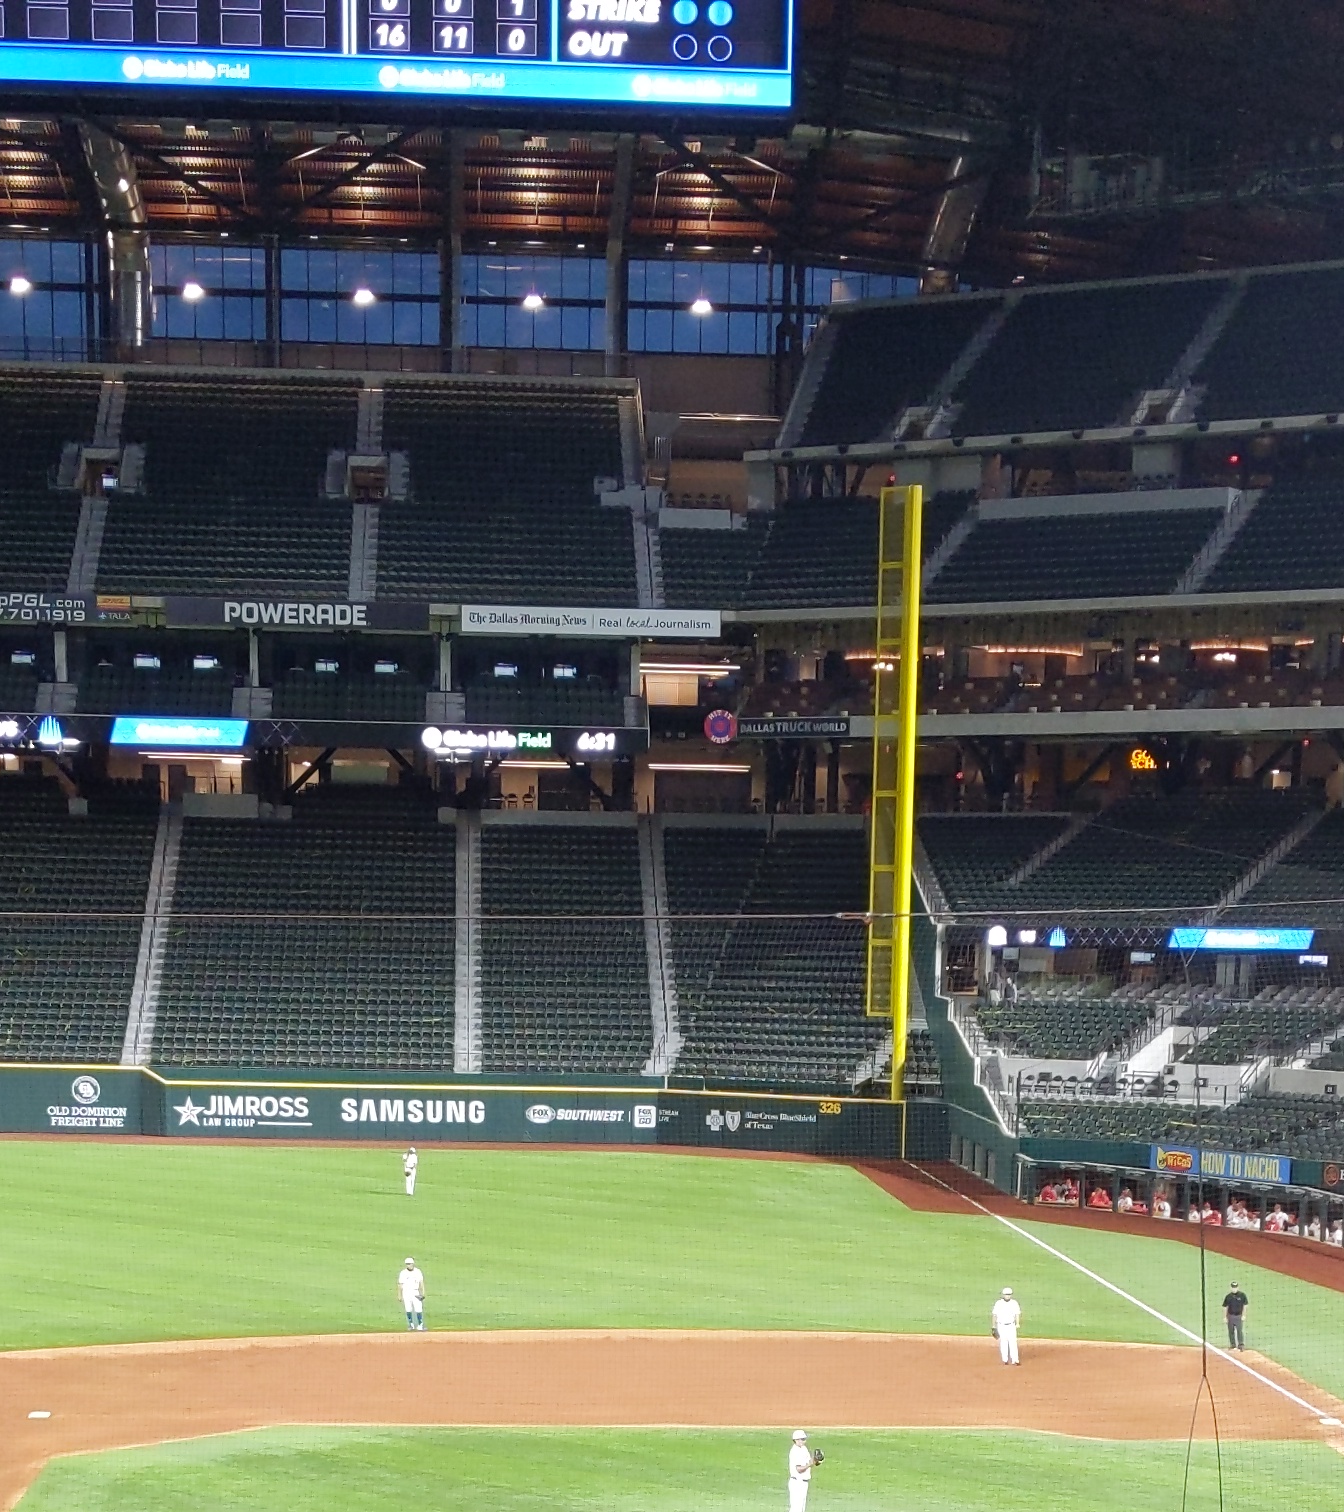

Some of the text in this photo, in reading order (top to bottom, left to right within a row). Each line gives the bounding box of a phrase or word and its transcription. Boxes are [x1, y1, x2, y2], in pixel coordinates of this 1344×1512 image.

[567, 0, 660, 23] STRIKE
[376, 23, 405, 47] 16
[440, 26, 468, 49] 11
[508, 28, 526, 51] 0
[567, 31, 628, 57] OUT
[217, 64, 250, 80] Field
[472, 73, 505, 89] Field
[224, 602, 367, 626] POWERADE
[468, 611, 587, 627] The Dallas Morning News
[599, 617, 622, 628] Real
[626, 616, 653, 629] local
[708, 709, 722, 721] HIT
[740, 721, 847, 734] DALLAS TRUCK WORLD
[443, 729, 551, 749] Globe Life Field
[577, 731, 616, 750] 6:31
[710, 734, 731, 744] HERE
[47, 1105, 127, 1117] OLD DOMINION
[341, 1098, 486, 1124] SAMSUNG
[532, 1108, 622, 1122] FOX SOUTHWEST
[638, 1108, 652, 1116] FOX
[658, 1109, 679, 1117] STREAM
[818, 1102, 842, 1115] 326
[50, 1116, 124, 1128] FREIGHT LINE
[203, 1117, 255, 1128] LAW GROUP
[638, 1117, 652, 1125] GO
[752, 1122, 774, 1130] Texas
[1200, 1152, 1226, 1175] HOW
[1228, 1154, 1242, 1177] TO
